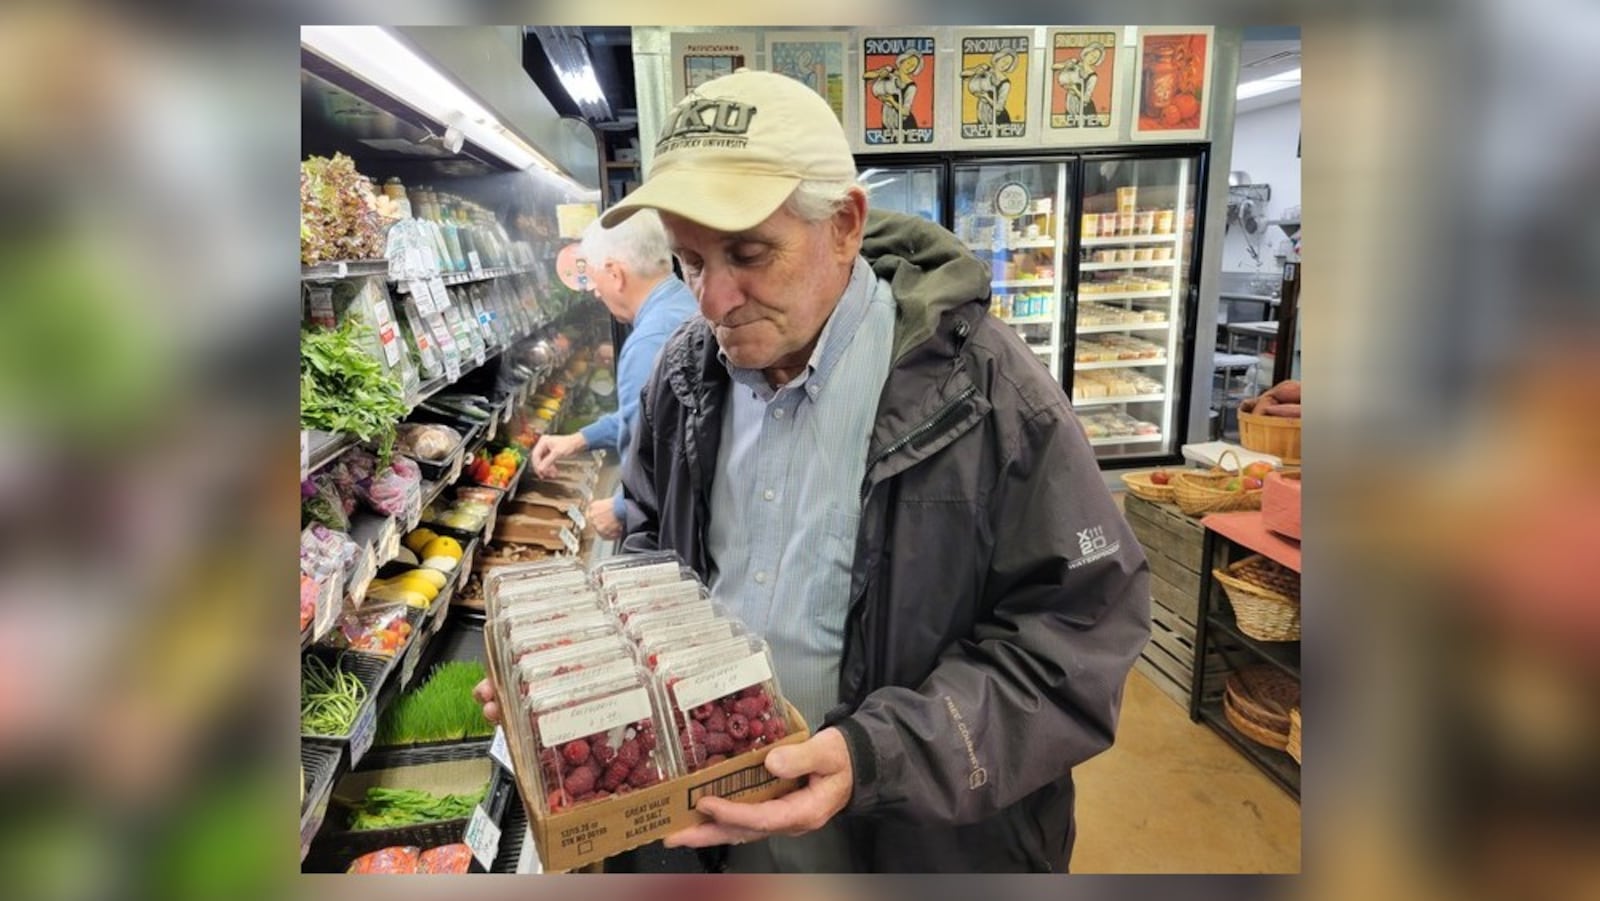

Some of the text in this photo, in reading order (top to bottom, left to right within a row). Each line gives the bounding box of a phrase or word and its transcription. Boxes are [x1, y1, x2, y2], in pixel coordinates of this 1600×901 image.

[866, 39, 933, 54] SNOWVILLE
[964, 38, 1028, 54] SNOWVILLE
[702, 138, 748, 150] UNIVERSITY
[624, 797, 671, 818] GREAT VALUE
[634, 809, 662, 825] NO SALT
[625, 816, 671, 839] BLACK BEANS
